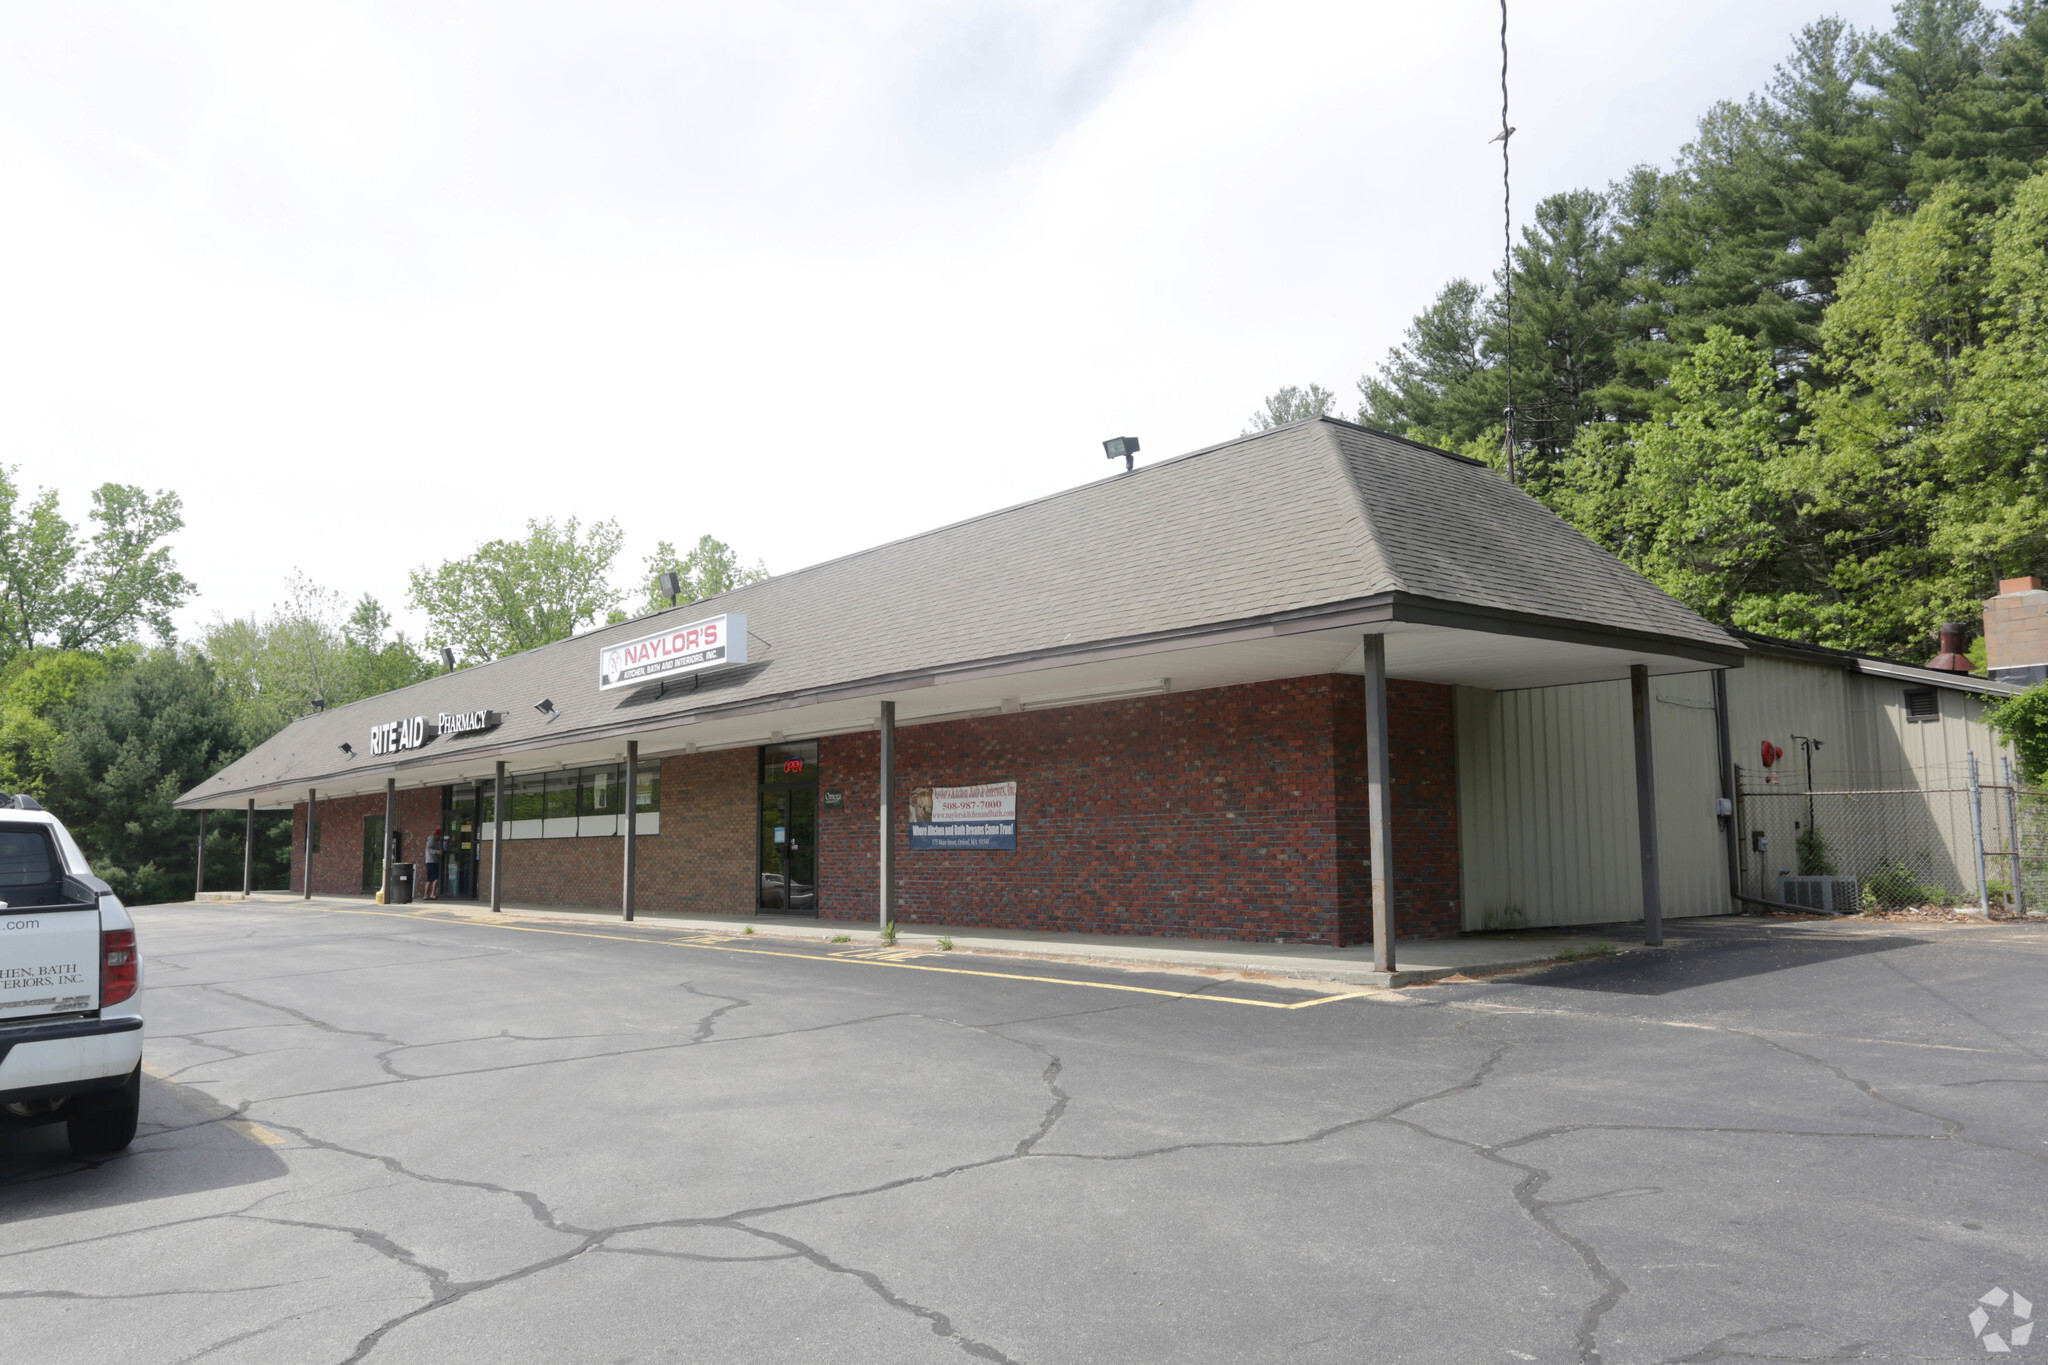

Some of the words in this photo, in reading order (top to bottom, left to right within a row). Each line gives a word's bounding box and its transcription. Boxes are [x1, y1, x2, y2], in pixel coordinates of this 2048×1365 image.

[624, 625, 717, 665] NAYLOR'S
[623, 666, 646, 679] KITCHEN,
[647, 664, 661, 675] BATH
[661, 660, 674, 671] AND
[674, 654, 704, 667] INTERIORS,
[706, 650, 718, 660] INC.
[370, 721, 398, 755] RITE
[399, 715, 424, 750] AID
[784, 761, 802, 772] OPEN
[942, 800, 1002, 810] 508-987-7000
[945, 824, 954, 835] and
[2, 919, 40, 931] .com
[39, 963, 77, 976] BATH
[58, 973, 84, 985] INC.
